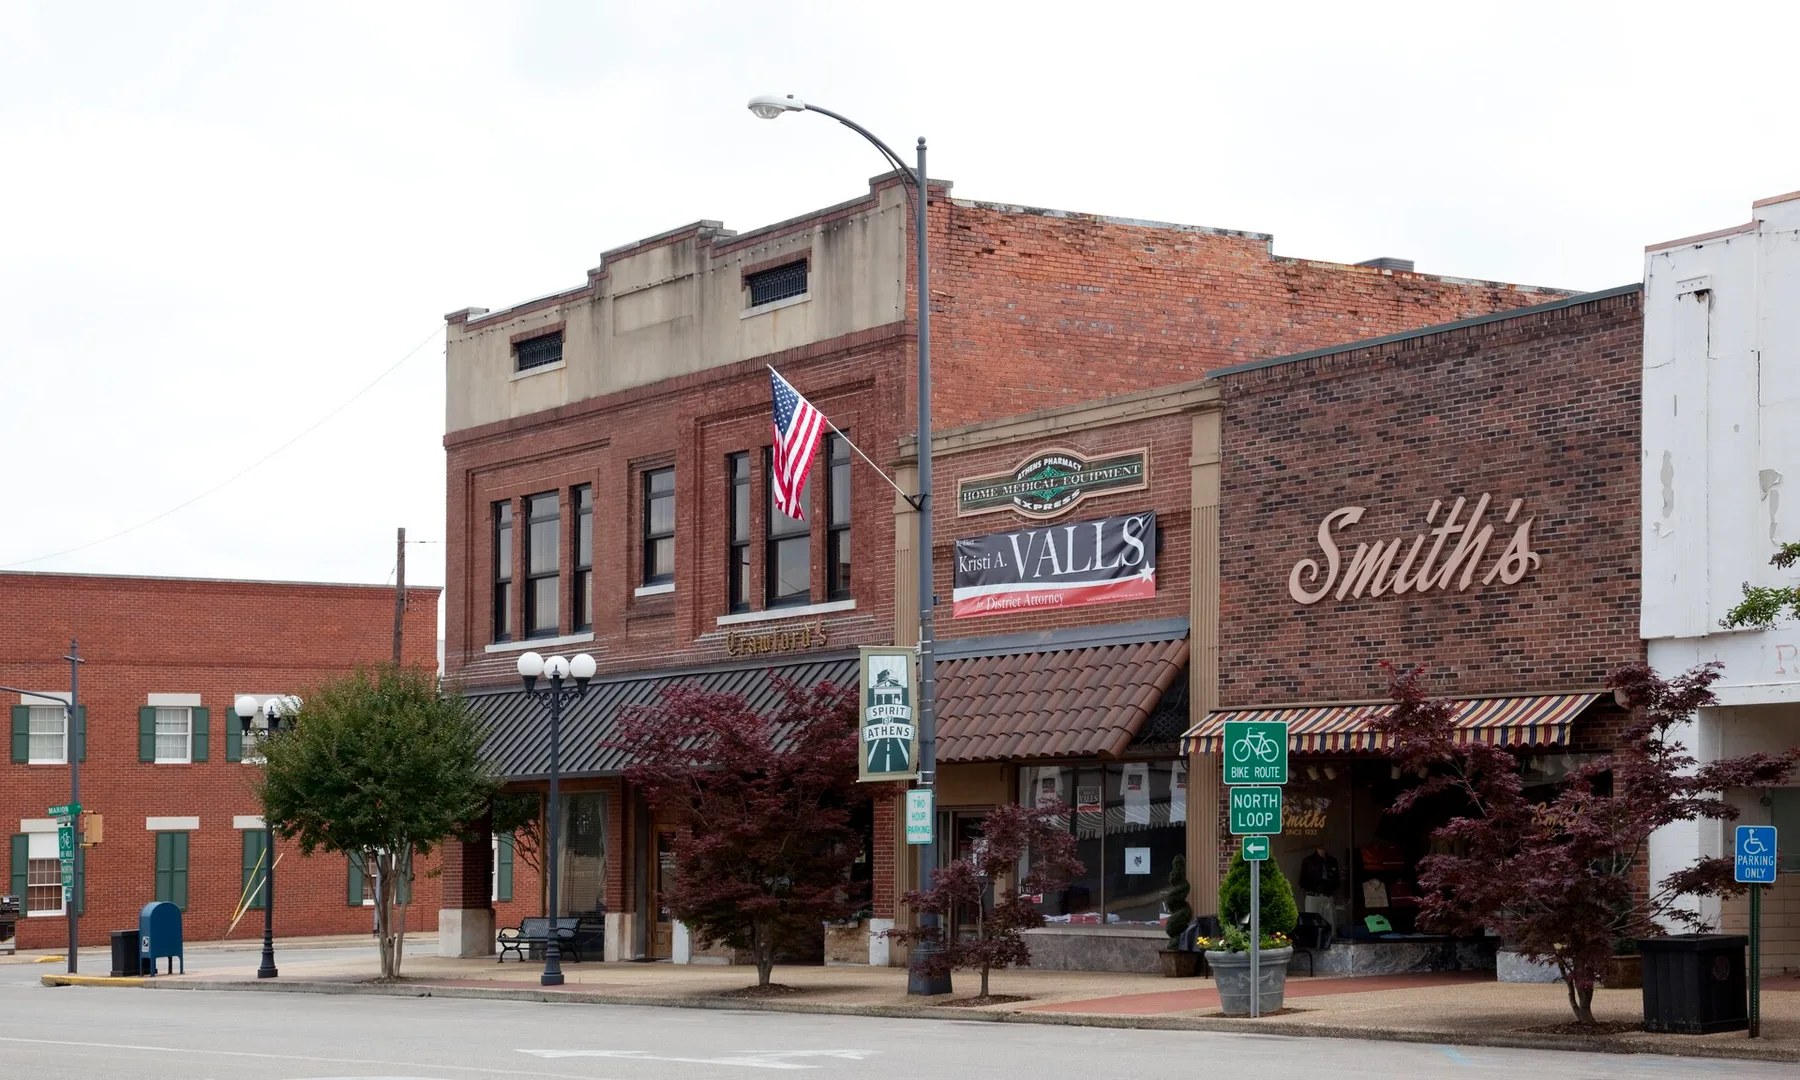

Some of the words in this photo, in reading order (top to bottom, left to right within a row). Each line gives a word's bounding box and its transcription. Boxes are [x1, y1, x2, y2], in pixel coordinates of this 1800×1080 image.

[1017, 461, 1042, 481] ATHENS
[1043, 457, 1082, 471] PHARMACY
[963, 487, 998, 502] HOME
[1002, 478, 1058, 496] MEDICAL
[1063, 465, 1141, 486] EQUIPMENT
[1013, 488, 1080, 511] EXPRESS
[958, 553, 991, 573] Kristi
[993, 551, 1008, 569] A.
[1007, 516, 1145, 580] VALLS
[1288, 492, 1542, 605] Smith's
[986, 595, 1022, 611] District
[1023, 591, 1065, 607] Attorney
[727, 618, 827, 657] Crawford's
[872, 706, 906, 717] SPIRIT
[868, 725, 910, 739] ATHENS
[1231, 766, 1250, 778] BIKE
[1254, 766, 1280, 778] ROUTE
[913, 799, 926, 808] TWO
[1234, 794, 1278, 808] NORTH
[48, 805, 69, 815] MARION
[911, 812, 926, 821] HOUR
[1238, 812, 1273, 827] LOOP
[908, 825, 931, 835] PARKING
[1737, 855, 1774, 866] PARKING
[1745, 868, 1766, 879] ONLY
